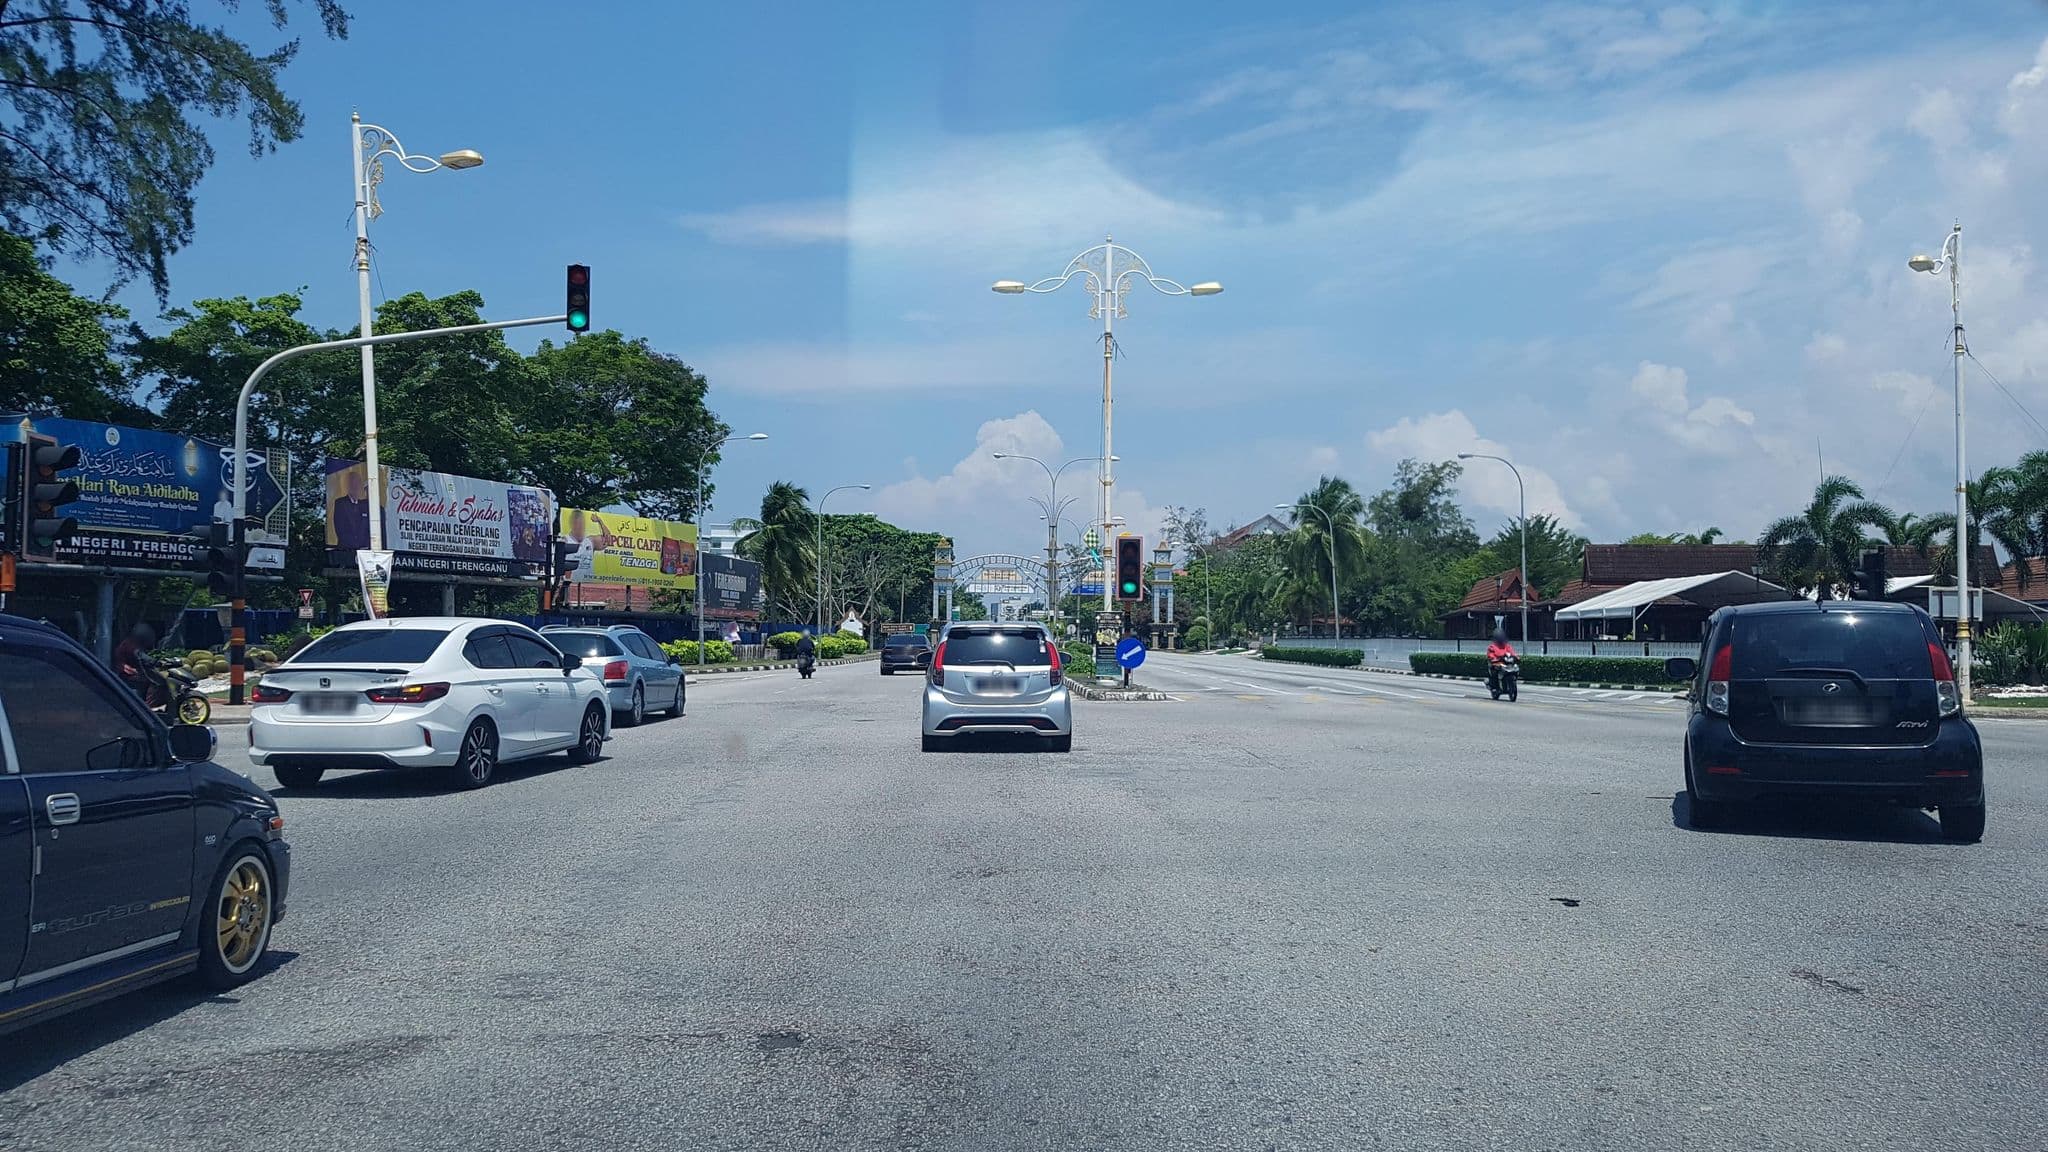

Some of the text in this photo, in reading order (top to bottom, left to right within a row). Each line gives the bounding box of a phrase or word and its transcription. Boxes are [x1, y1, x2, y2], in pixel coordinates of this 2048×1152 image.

[72, 474, 200, 502] Hari Raya Aidiladha
[391, 485, 505, 526] Tahniah & Syabas
[399, 518, 500, 540] PENCAPAIAN CEMERLANG
[71, 536, 212, 555] NEGERI TERENGG
[415, 532, 446, 543] PELAJARAN
[446, 536, 473, 545] MALAYSIA
[408, 541, 428, 551] NEGERI
[147, 552, 194, 561] SEJAHTERA
[620, 556, 658, 570] TENAGA
[416, 559, 449, 569] NEGERI
[451, 561, 508, 573] TERENGGANU
